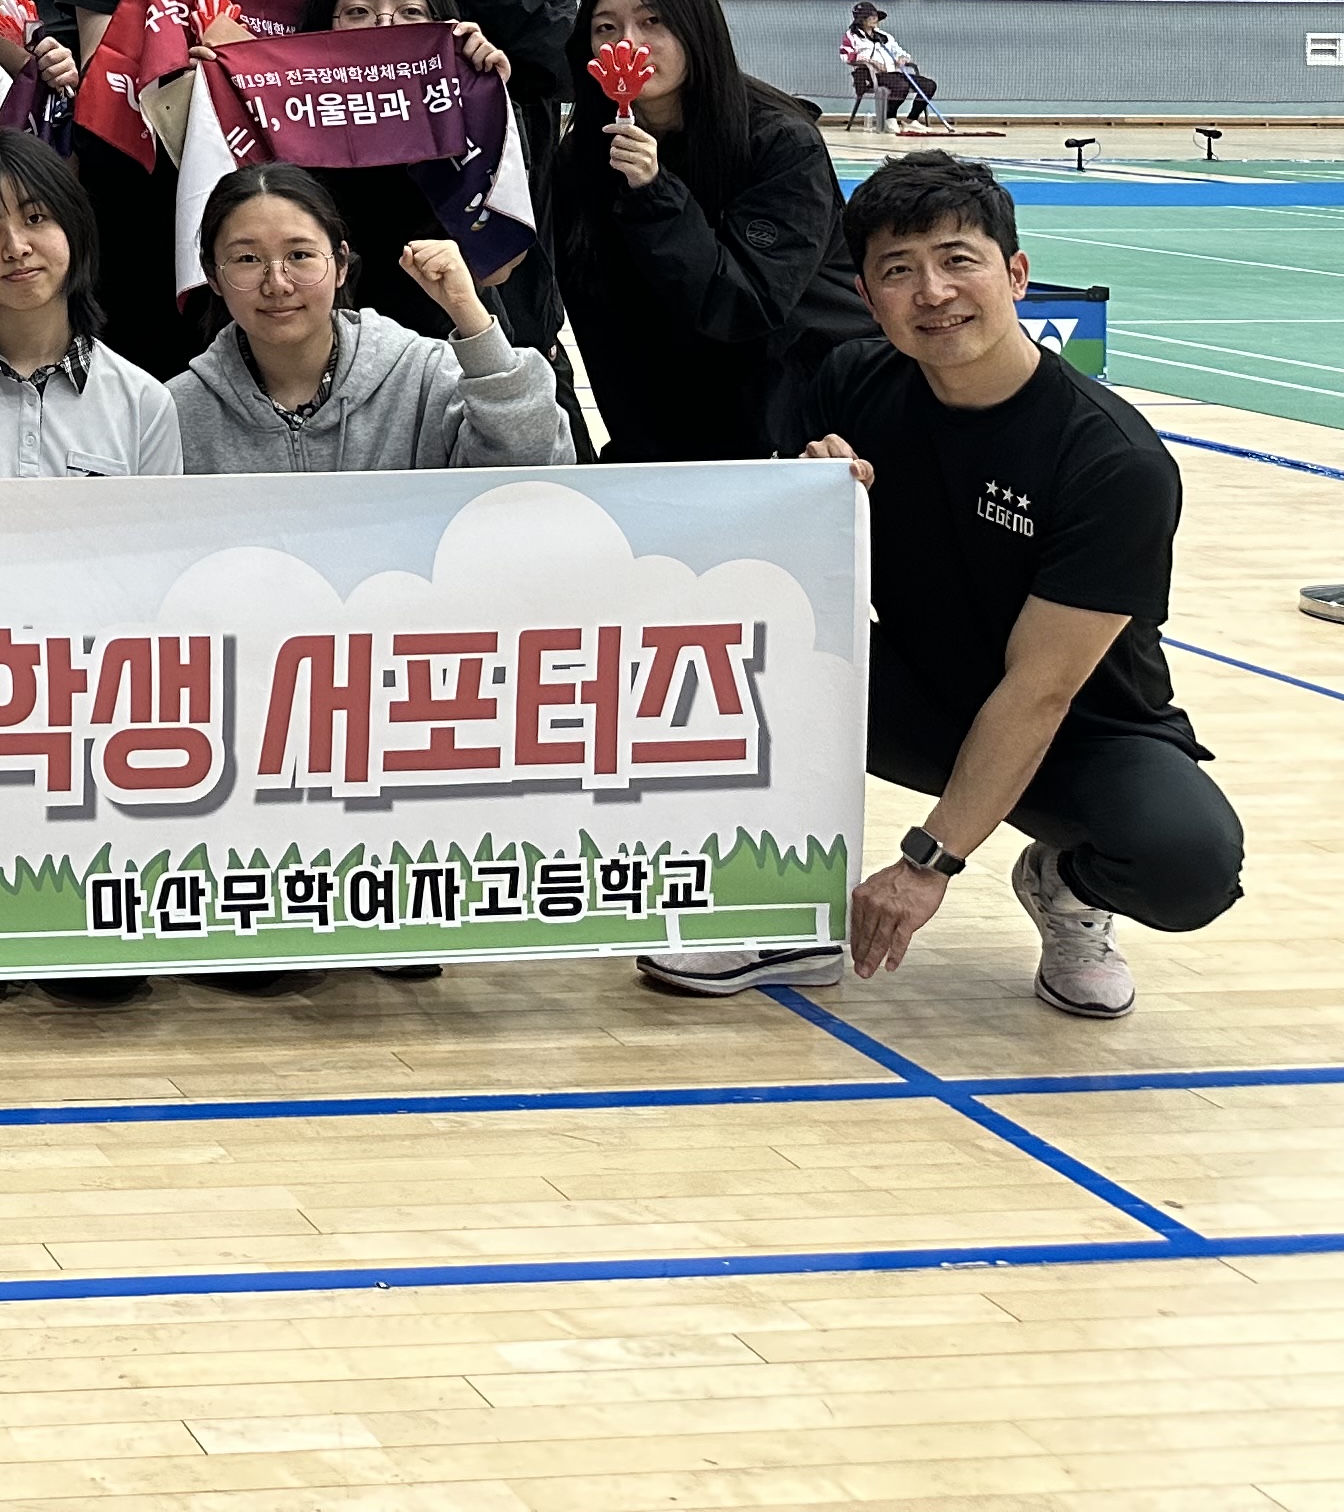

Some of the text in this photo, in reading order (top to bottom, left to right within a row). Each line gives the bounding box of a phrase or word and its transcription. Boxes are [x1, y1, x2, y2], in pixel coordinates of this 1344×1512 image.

[286, 53, 444, 85] 전국장애학생체육대회
[284, 88, 411, 129] 어울림과
[976, 496, 1035, 538] LEGEND
[257, 622, 748, 783] 서포터즈
[90, 857, 710, 936] 마산무학여자고등학교
